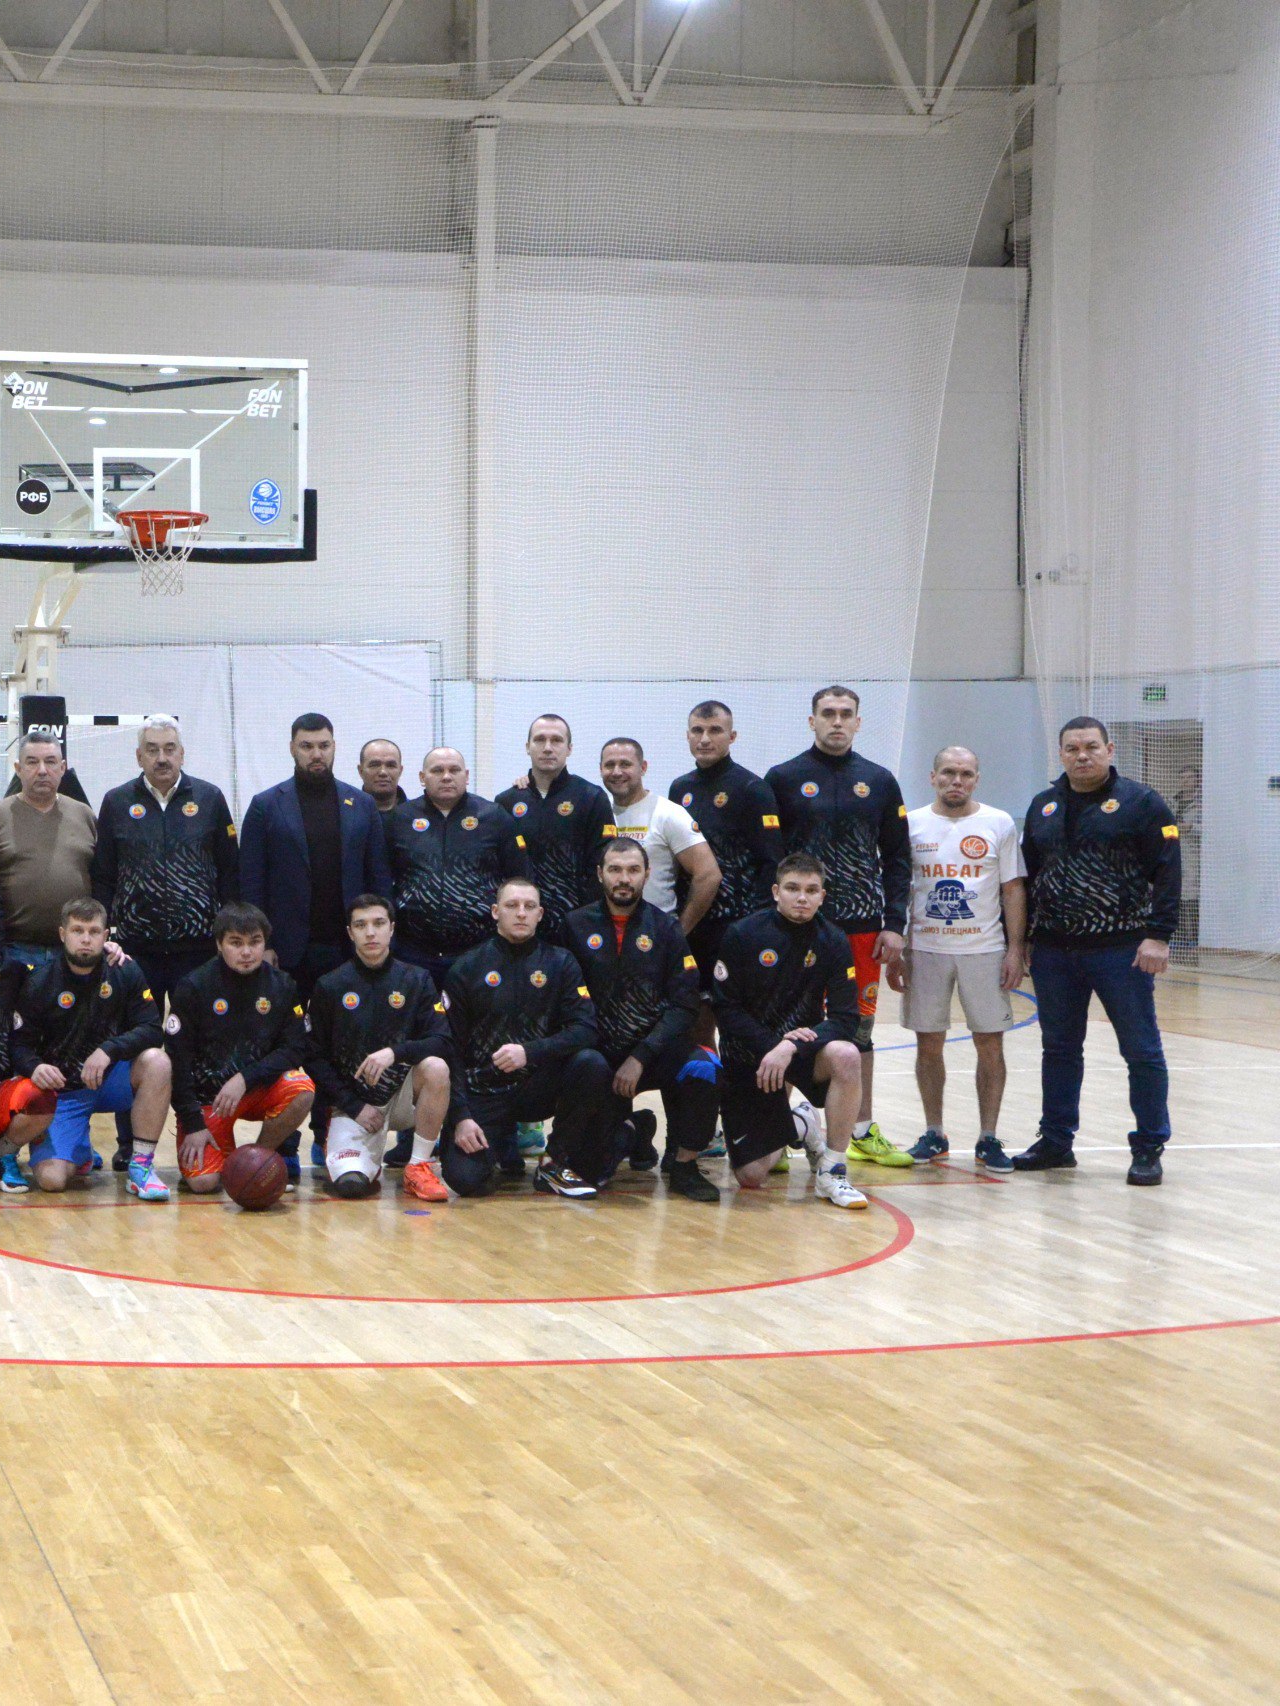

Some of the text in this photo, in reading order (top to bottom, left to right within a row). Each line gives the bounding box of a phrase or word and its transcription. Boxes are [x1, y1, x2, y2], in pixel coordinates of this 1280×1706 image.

[12, 381, 48, 395] FON
[11, 395, 48, 409] BET
[248, 389, 282, 403] FON
[247, 404, 282, 418] BET
[20, 491, 48, 503] РФБ
[921, 863, 984, 878] НАБАТ
